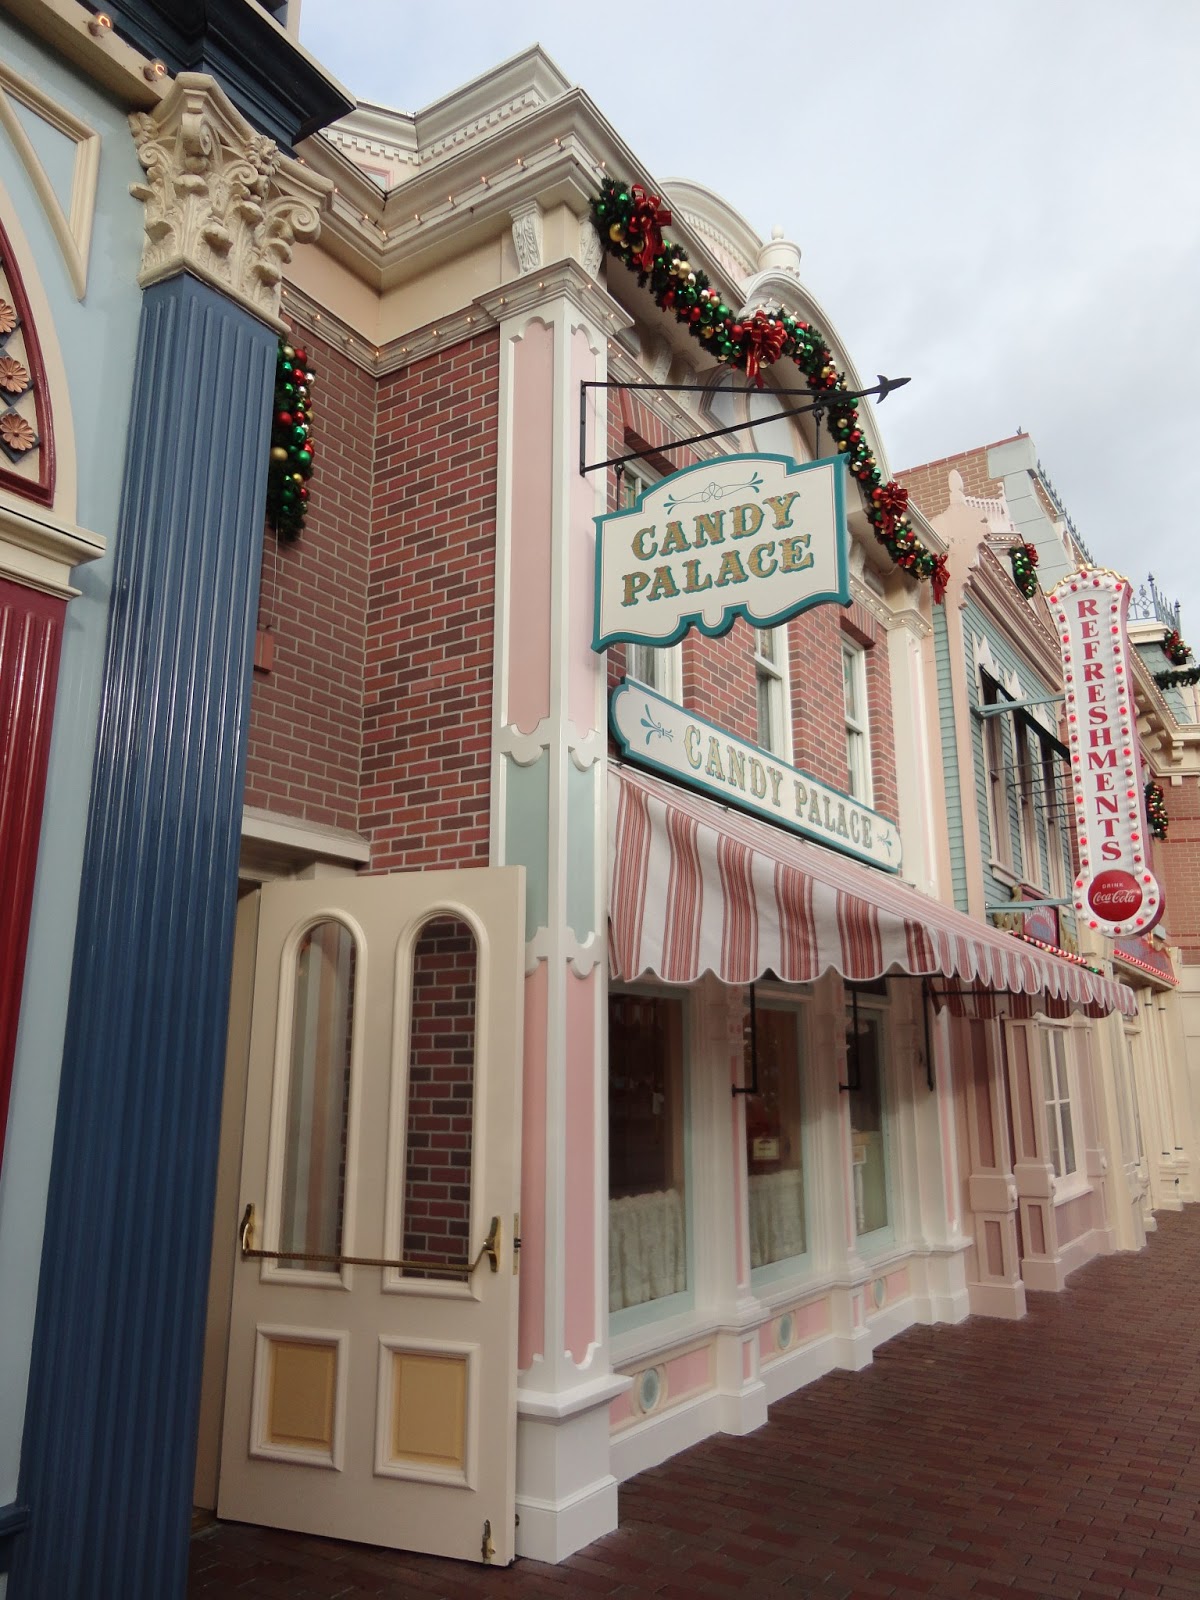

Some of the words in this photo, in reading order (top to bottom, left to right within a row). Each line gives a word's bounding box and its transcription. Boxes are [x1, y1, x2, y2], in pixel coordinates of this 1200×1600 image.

[631, 491, 800, 561] CANDY
[620, 533, 814, 607] PALACE
[1077, 598, 1122, 861] REFRESHMENTS
[683, 725, 783, 807] CANDY
[793, 780, 873, 849] PALACE
[1092, 889, 1136, 905] Coca-Cola
